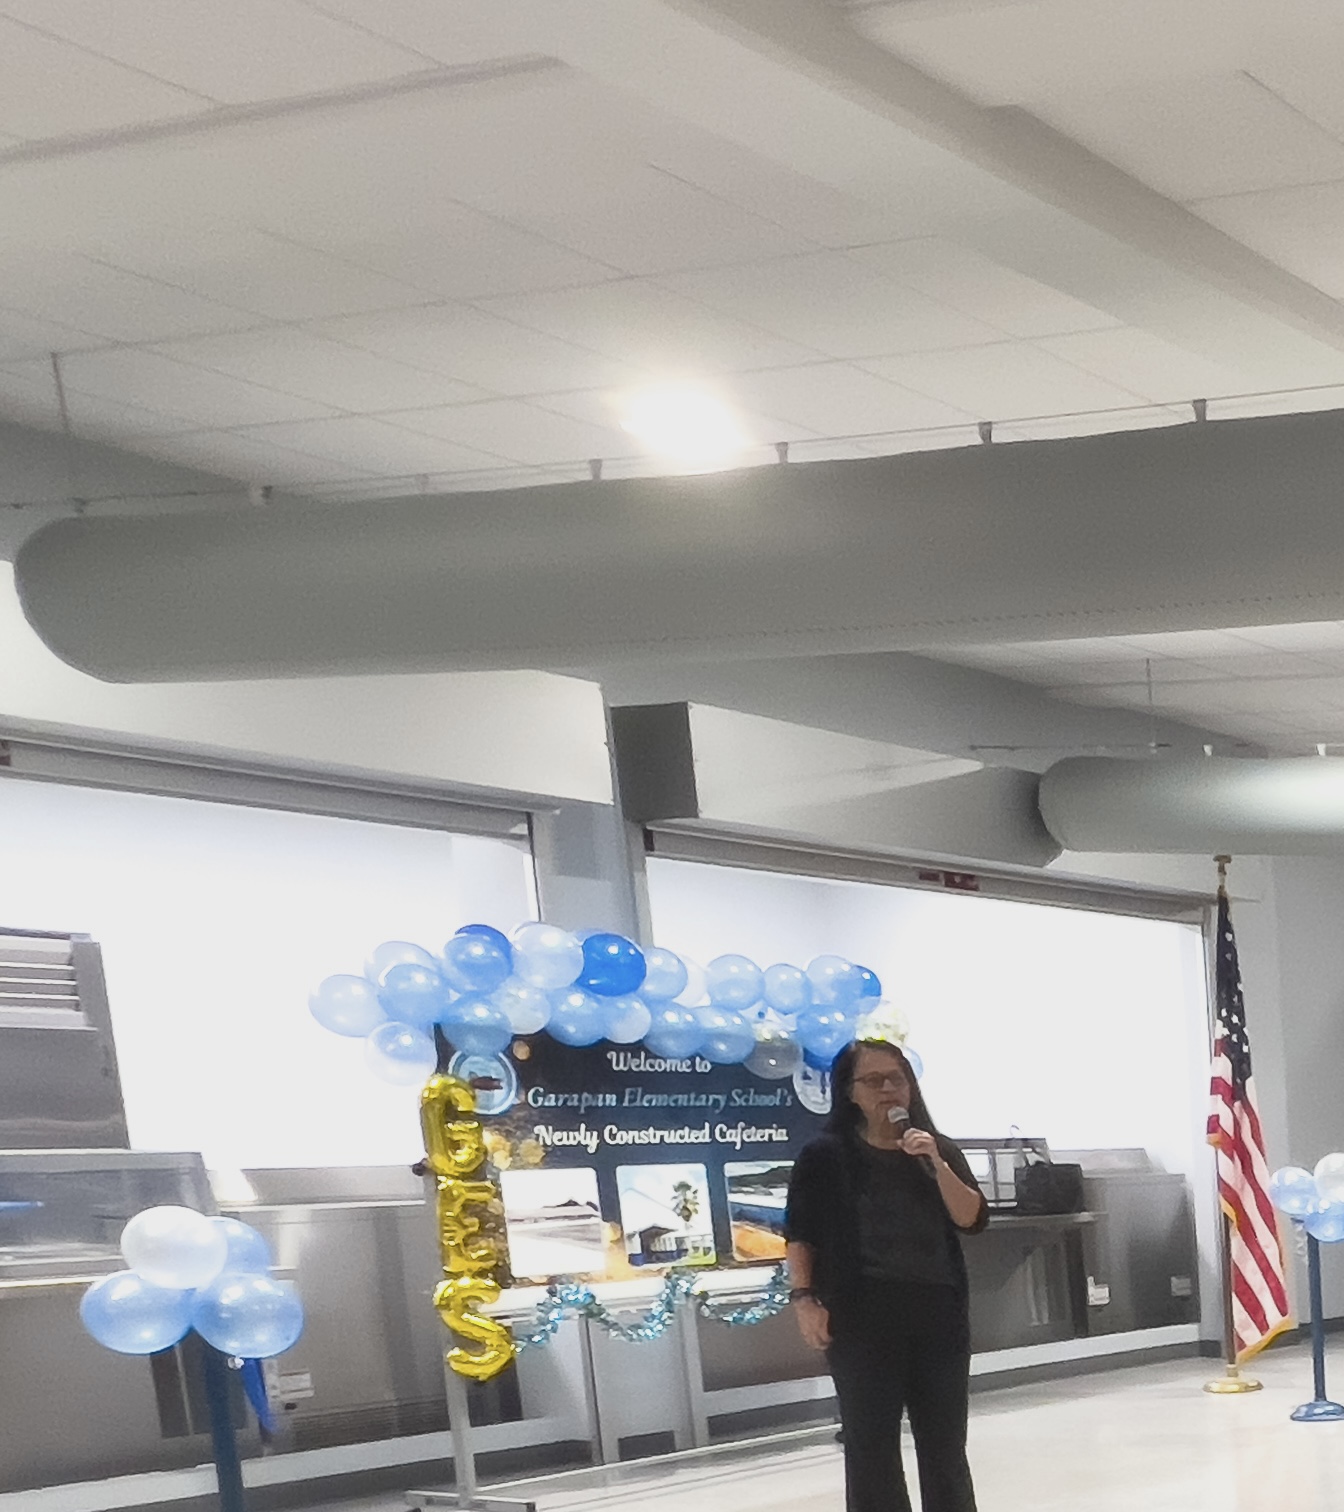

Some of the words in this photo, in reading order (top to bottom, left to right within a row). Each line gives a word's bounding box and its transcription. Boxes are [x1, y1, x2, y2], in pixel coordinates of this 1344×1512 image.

[607, 1050, 692, 1073] Welcome
[694, 1056, 712, 1074] to
[527, 1086, 617, 1113] Garapan
[622, 1087, 728, 1114] Elementary
[730, 1088, 793, 1107] School's
[533, 1123, 599, 1154] Newly
[603, 1122, 711, 1145] Constructed
[714, 1121, 789, 1151] Cafeteria
